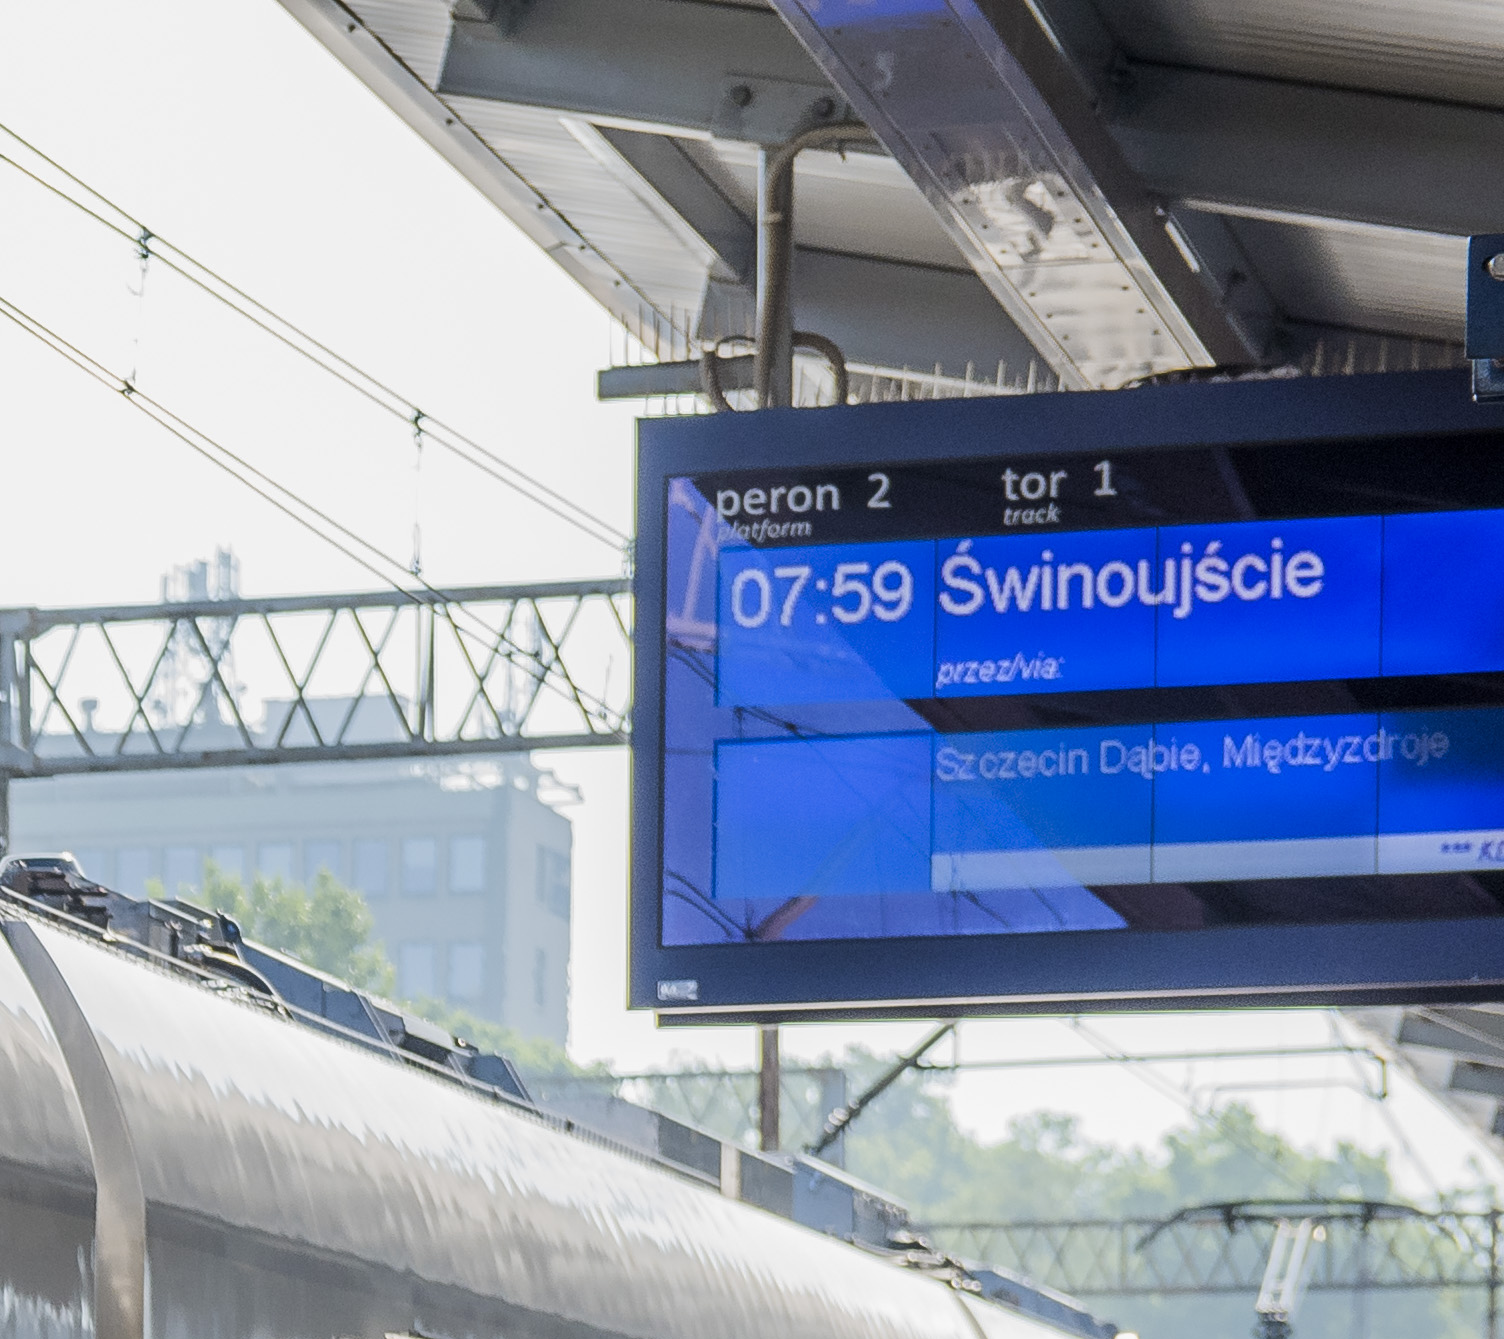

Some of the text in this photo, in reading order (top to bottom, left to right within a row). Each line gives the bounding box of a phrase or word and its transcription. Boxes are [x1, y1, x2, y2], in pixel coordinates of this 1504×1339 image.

[716, 472, 892, 519] peron 2
[1002, 460, 1118, 502] tor 1
[716, 517, 813, 543] platform
[1003, 502, 1061, 527] track
[731, 558, 914, 630] 07:59
[938, 537, 1326, 620] Świnoujście
[936, 742, 1089, 783] Szczecin
[1222, 725, 1451, 775] Międzyzdroje
